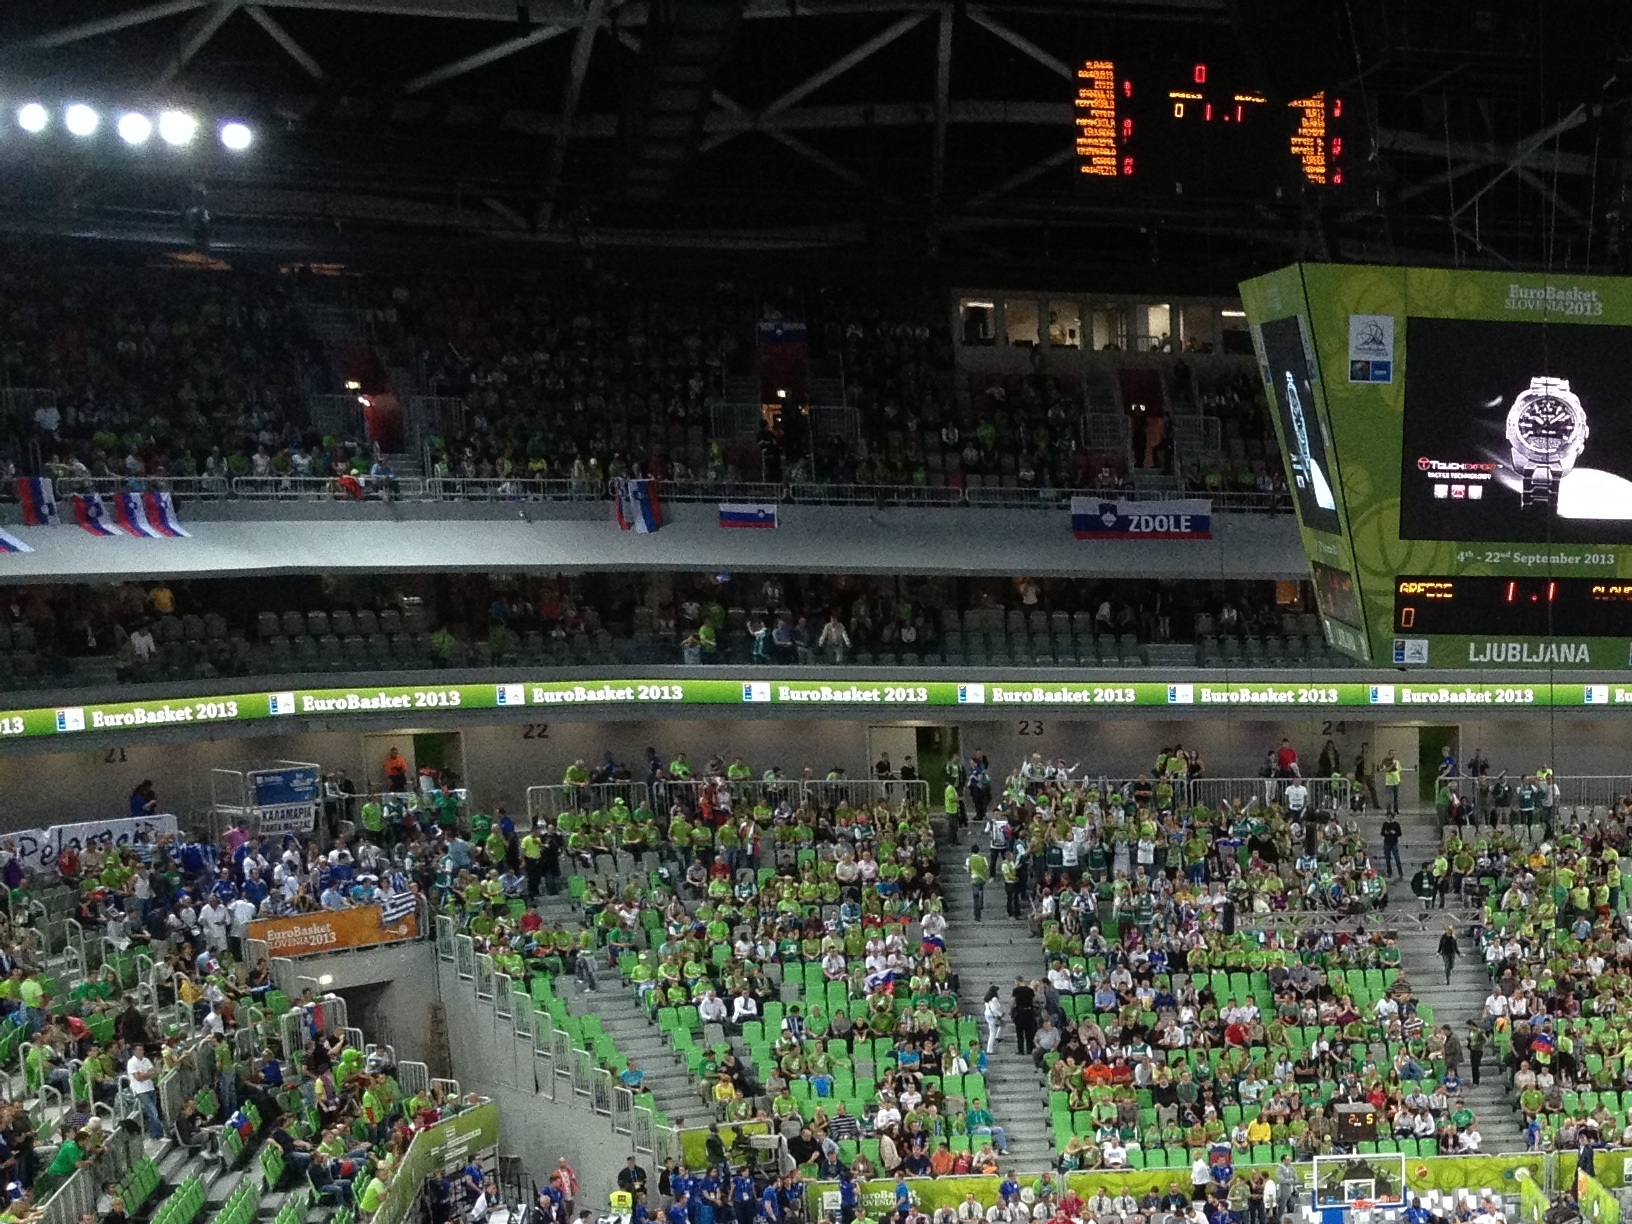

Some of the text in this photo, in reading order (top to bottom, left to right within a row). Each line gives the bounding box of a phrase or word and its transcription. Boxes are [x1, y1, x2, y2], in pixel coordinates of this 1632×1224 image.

[1509, 284, 1599, 301] EuroBasket
[1505, 299, 1565, 313] SLOVENIA
[1128, 515, 1191, 532] ZDOLE
[1457, 551, 1474, 562] 4th
[1485, 551, 1511, 563] 22nd
[1513, 552, 1581, 566] September
[1584, 553, 1615, 565] 2013
[1469, 642, 1590, 663] LJUBLJANA
[532, 680, 685, 703] EuroBasket 2013
[778, 685, 929, 703] EuroBasket 2013
[992, 687, 1137, 703] EuroBasket 2013
[1201, 687, 1339, 703] EuroBasket 2013
[1402, 688, 1535, 705] EuroBasket 2013
[302, 690, 462, 711] EuroBasket 2013
[92, 701, 239, 728] EuroBasket 2013
[0, 716, 25, 735] 13
[523, 724, 549, 739] 22
[1019, 720, 1044, 737] 23
[1321, 721, 1346, 736] 24
[266, 922, 331, 943] EuroBasket
[309, 931, 337, 946] 2013
